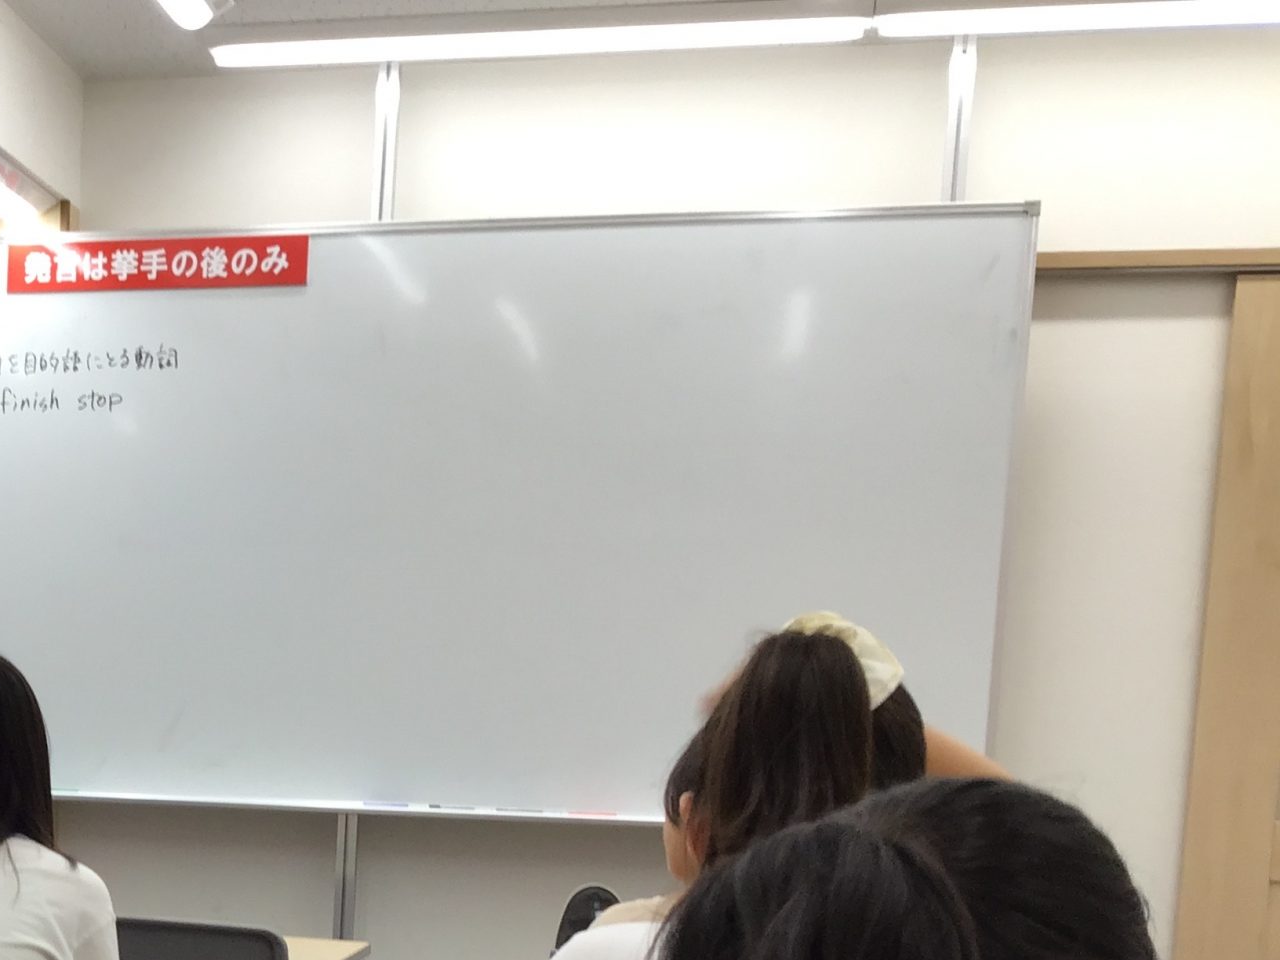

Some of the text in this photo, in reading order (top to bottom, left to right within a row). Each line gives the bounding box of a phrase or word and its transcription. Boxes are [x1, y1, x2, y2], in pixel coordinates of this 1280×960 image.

[24, 244, 289, 284] 発言は挙手の後のみ
[0, 386, 60, 414] finish
[77, 389, 123, 413] stop
